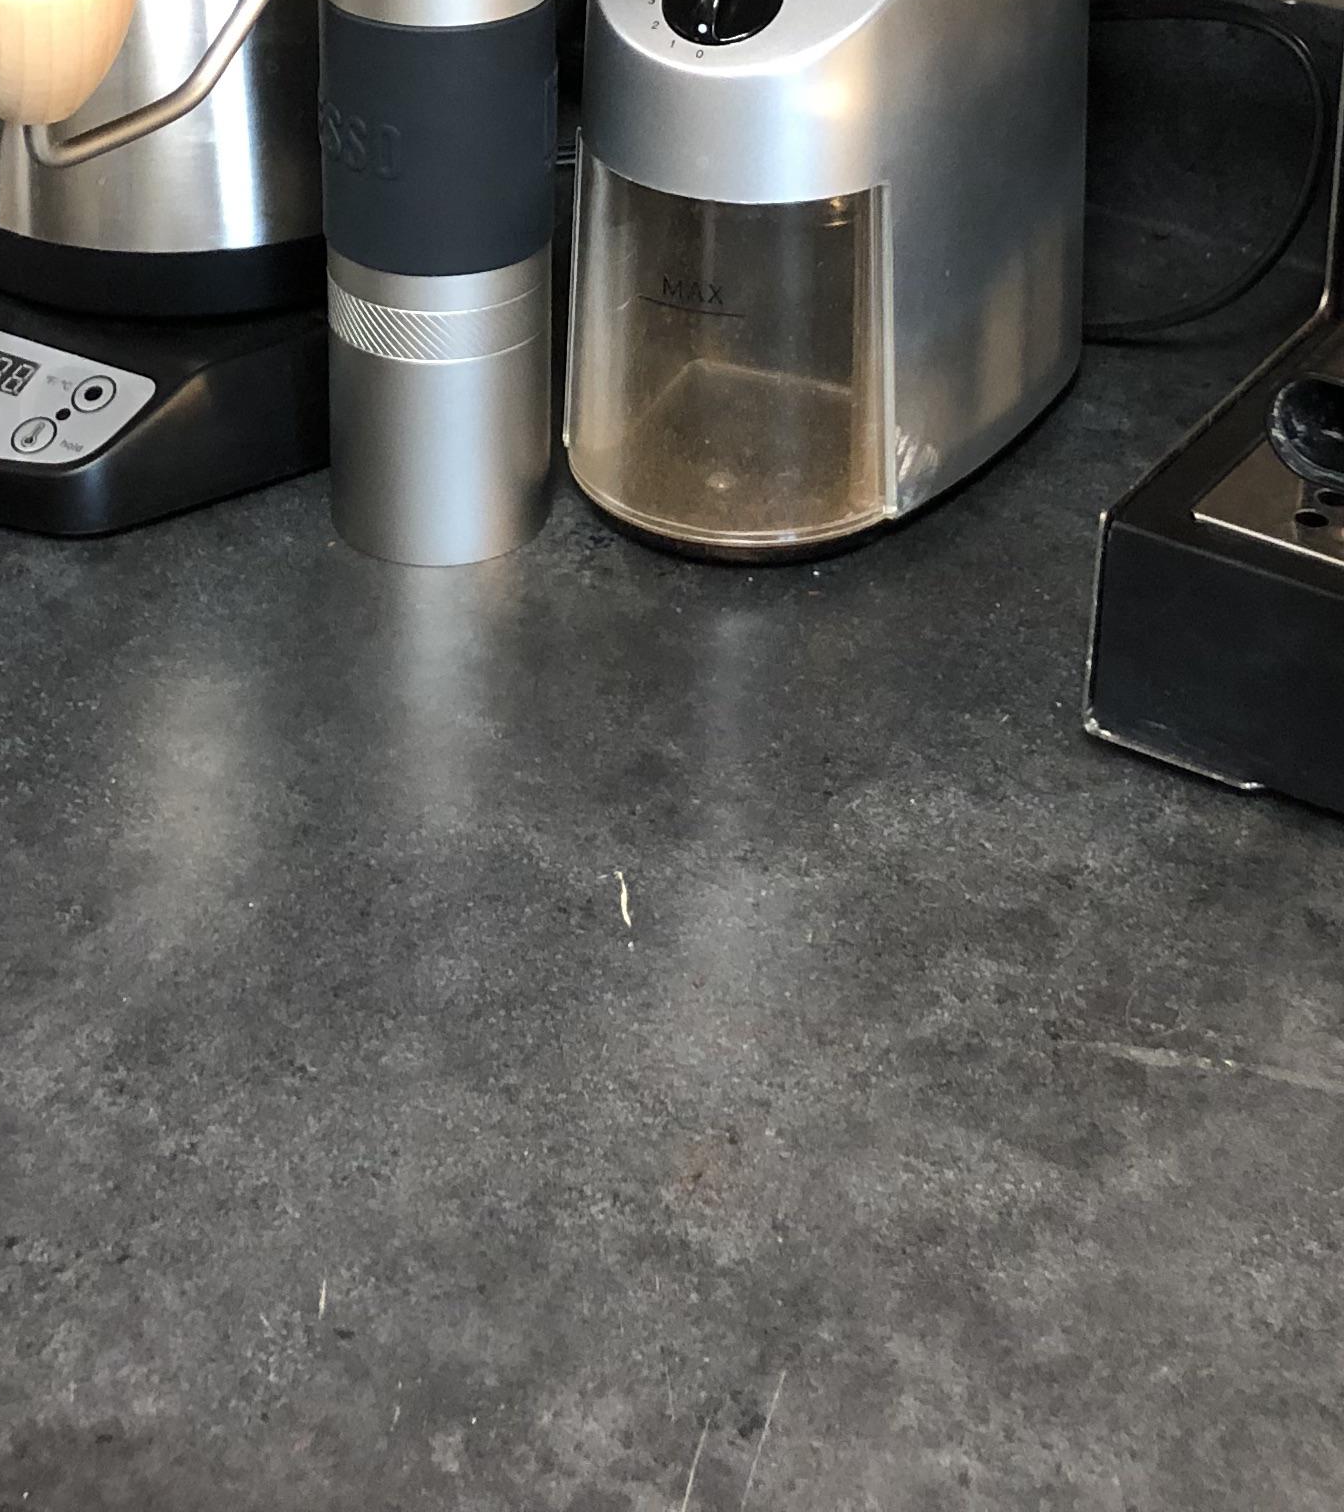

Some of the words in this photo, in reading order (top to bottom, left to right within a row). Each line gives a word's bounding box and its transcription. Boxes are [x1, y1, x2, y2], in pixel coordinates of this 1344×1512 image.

[652, 21, 659, 29] 2
[670, 40, 675, 48] 1
[696, 50, 704, 58] 0
[663, 274, 723, 304] MAX
